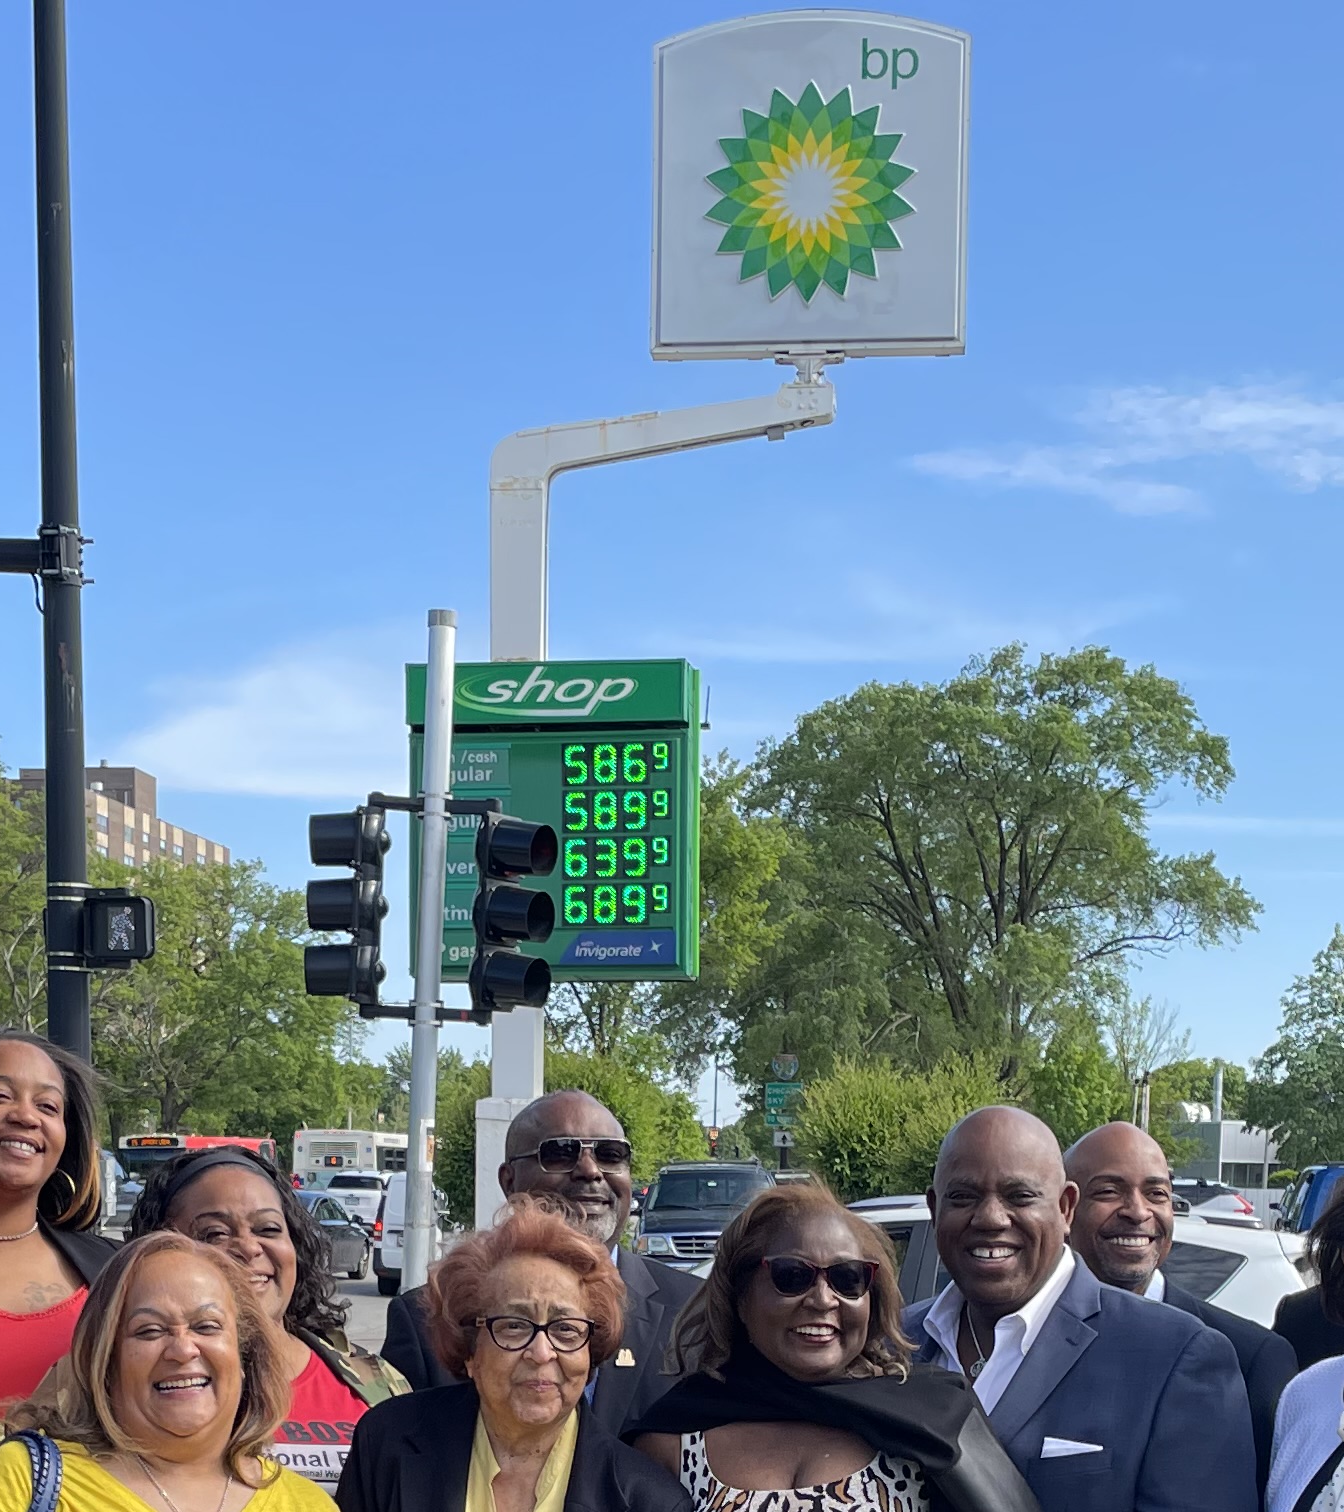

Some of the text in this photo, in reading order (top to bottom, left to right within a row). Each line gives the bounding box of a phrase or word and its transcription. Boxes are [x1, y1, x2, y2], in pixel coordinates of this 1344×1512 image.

[861, 37, 920, 90] bp
[485, 666, 635, 716] shop
[444, 904, 472, 921] tim
